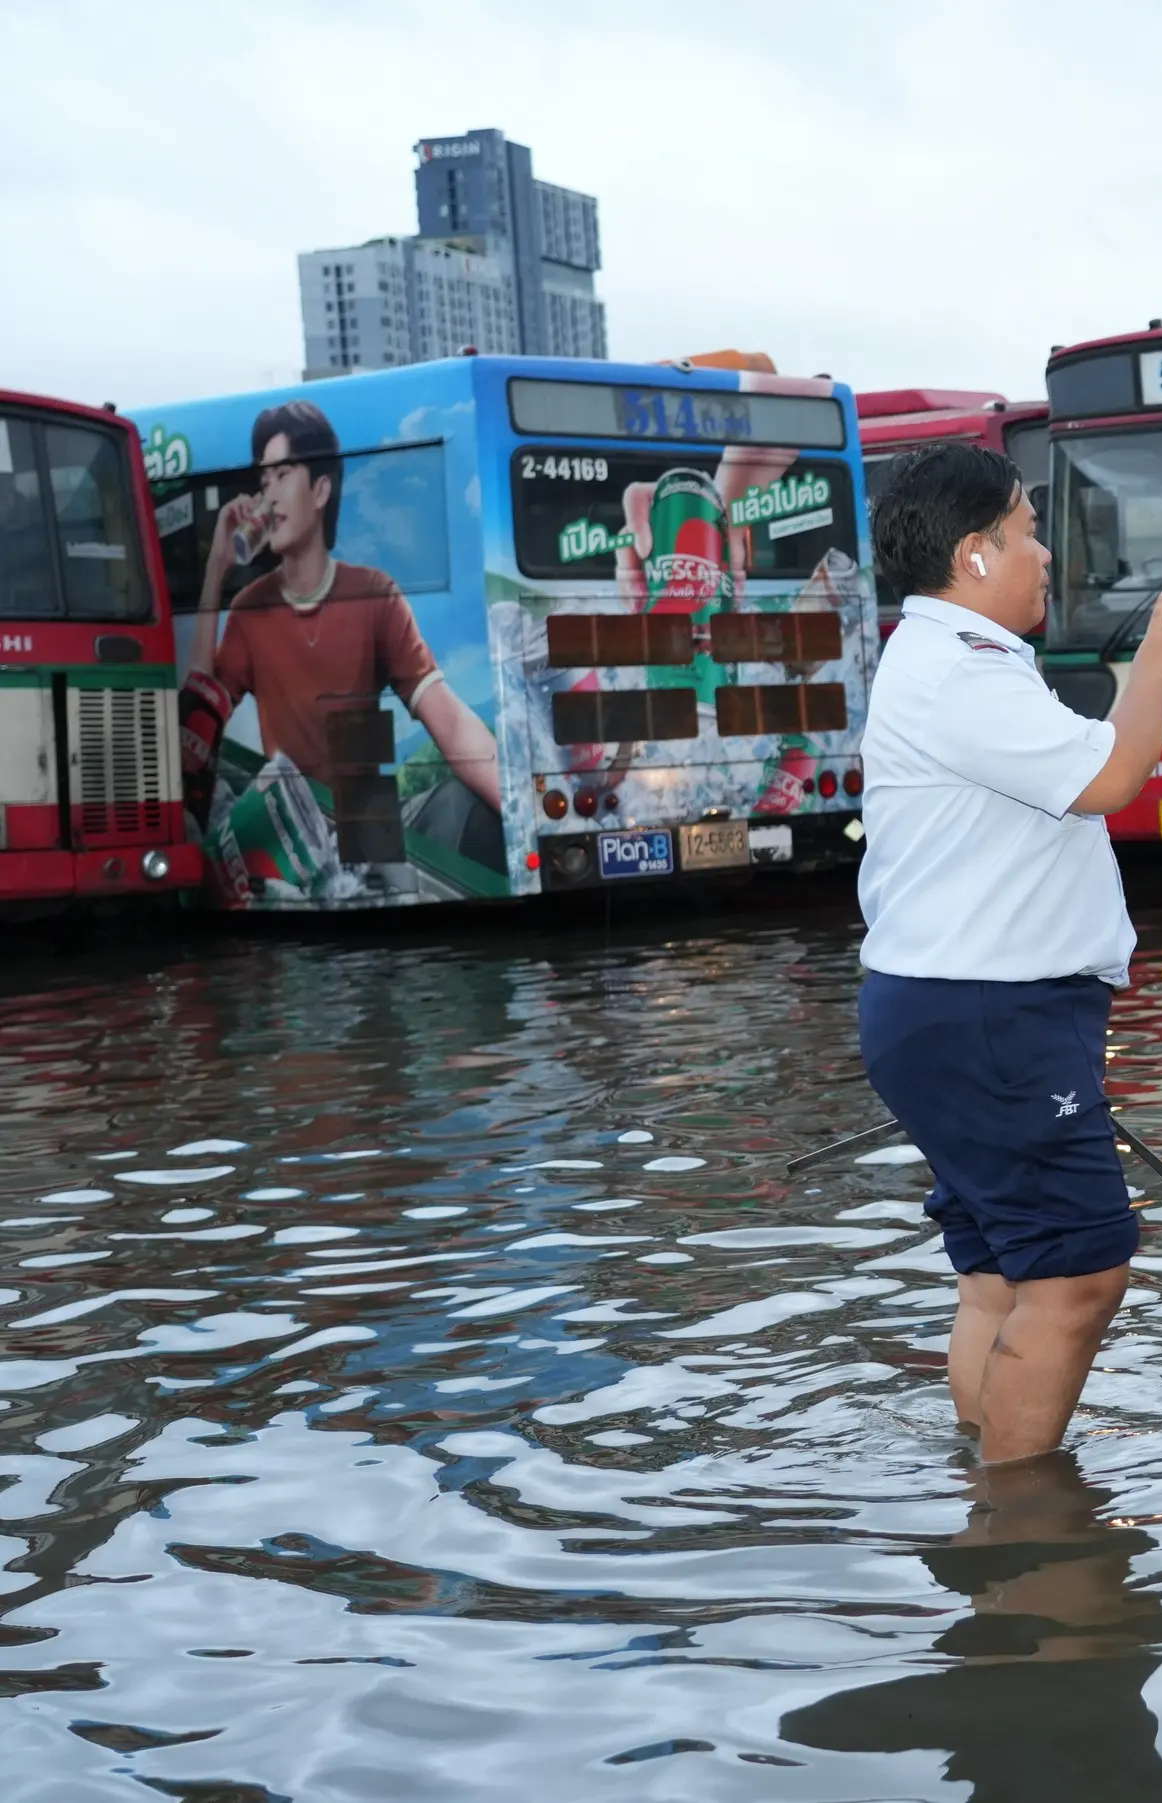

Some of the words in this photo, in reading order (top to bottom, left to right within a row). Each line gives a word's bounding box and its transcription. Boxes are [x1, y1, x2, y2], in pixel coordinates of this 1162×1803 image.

[622, 390, 699, 437] 514
[521, 455, 608, 482] 2-44169
[731, 473, 830, 525] แล้วไปต่อ
[0, 635, 33, 652] HI
